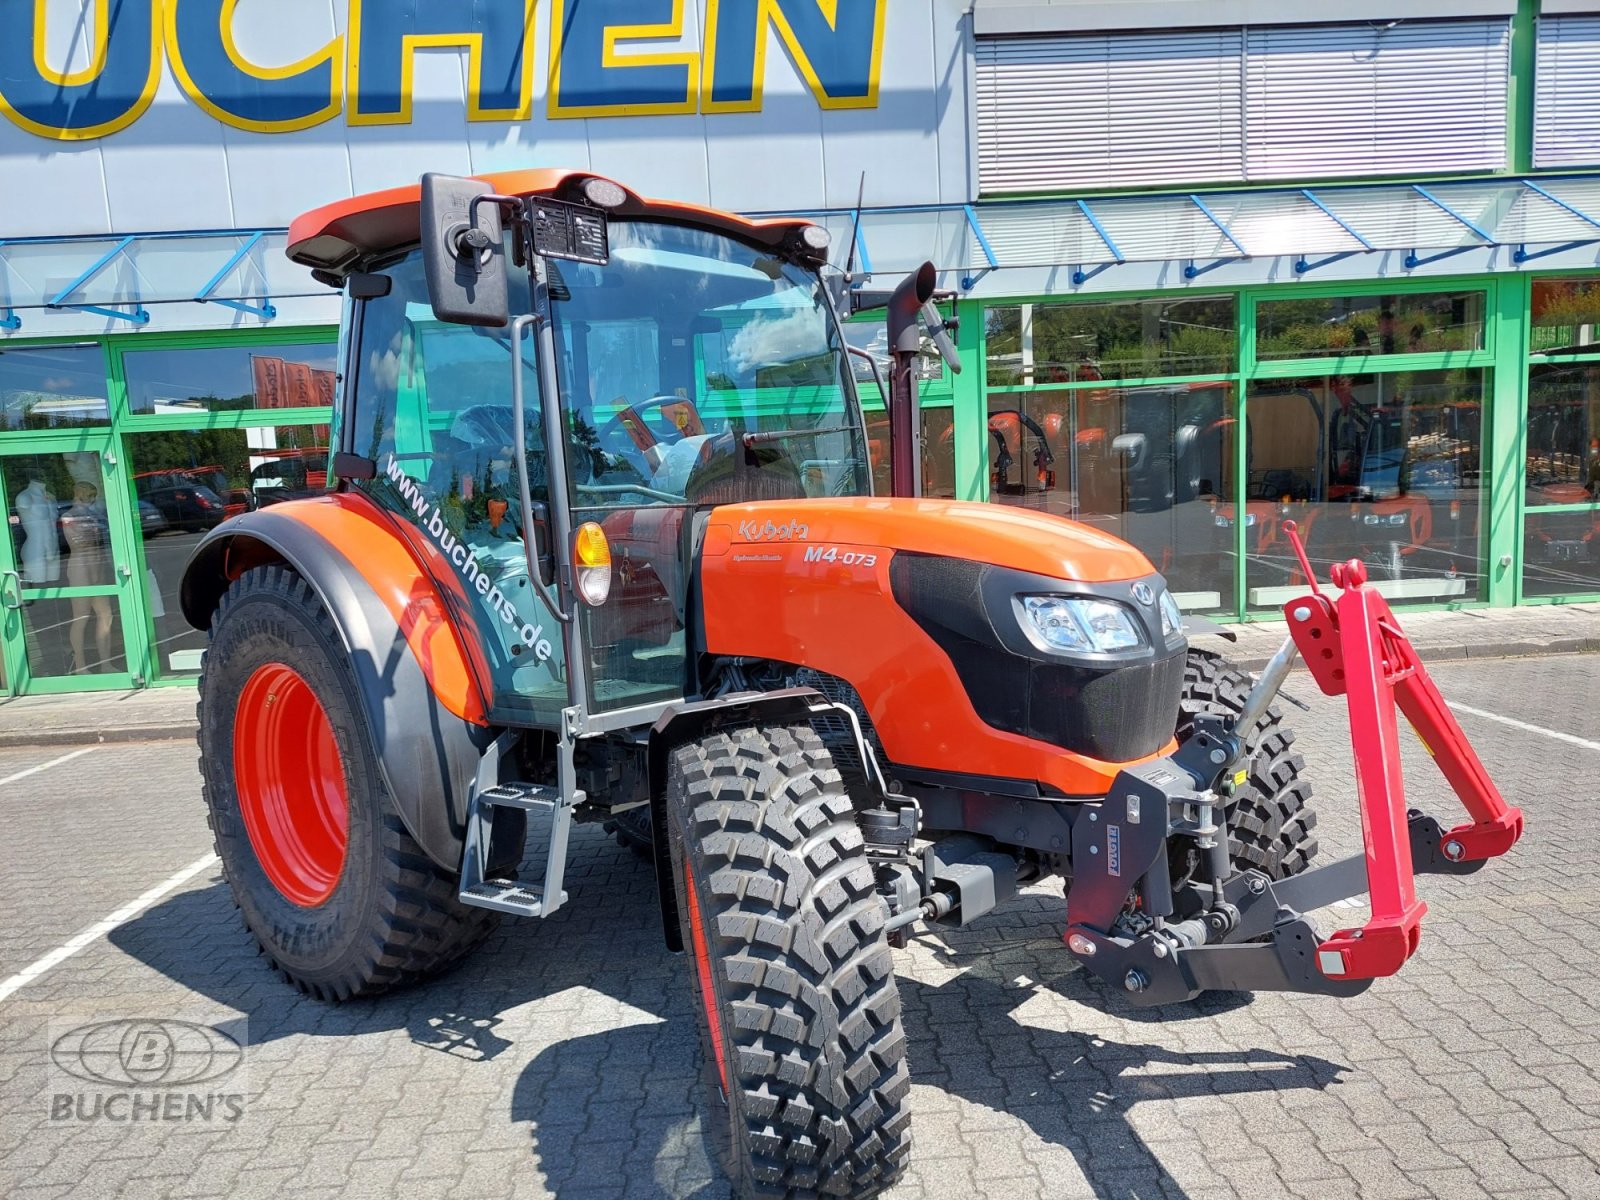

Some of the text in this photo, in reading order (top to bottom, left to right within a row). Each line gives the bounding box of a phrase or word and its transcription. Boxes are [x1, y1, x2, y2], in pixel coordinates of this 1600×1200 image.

[738, 518, 810, 541] Kubota
[385, 453, 552, 660] www.buchens.de
[803, 545, 877, 567] M4-073
